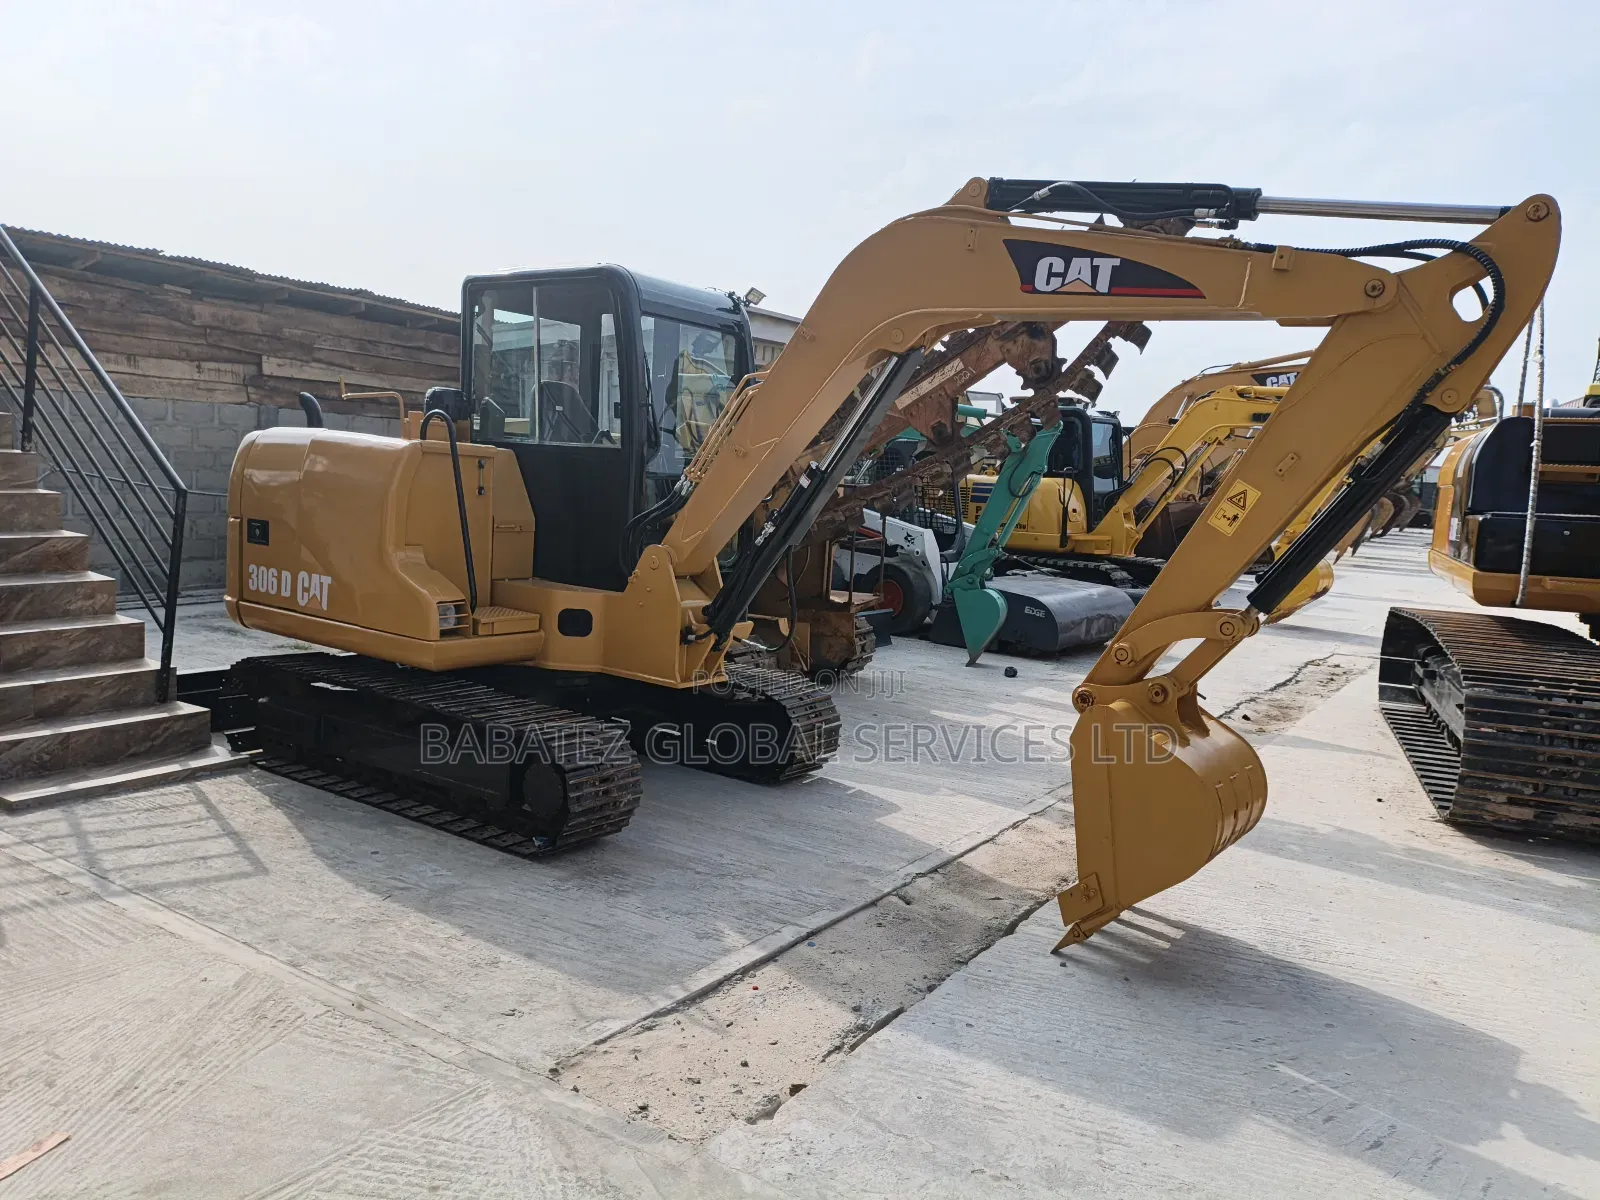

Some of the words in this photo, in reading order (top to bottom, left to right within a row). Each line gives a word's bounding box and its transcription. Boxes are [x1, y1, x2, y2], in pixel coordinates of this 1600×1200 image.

[1034, 256, 1121, 294] CAT
[1265, 372, 1298, 388] CAT
[248, 564, 278, 595] 306
[281, 569, 292, 598] D
[297, 570, 332, 611] CAT
[1024, 605, 1046, 618] EDGE
